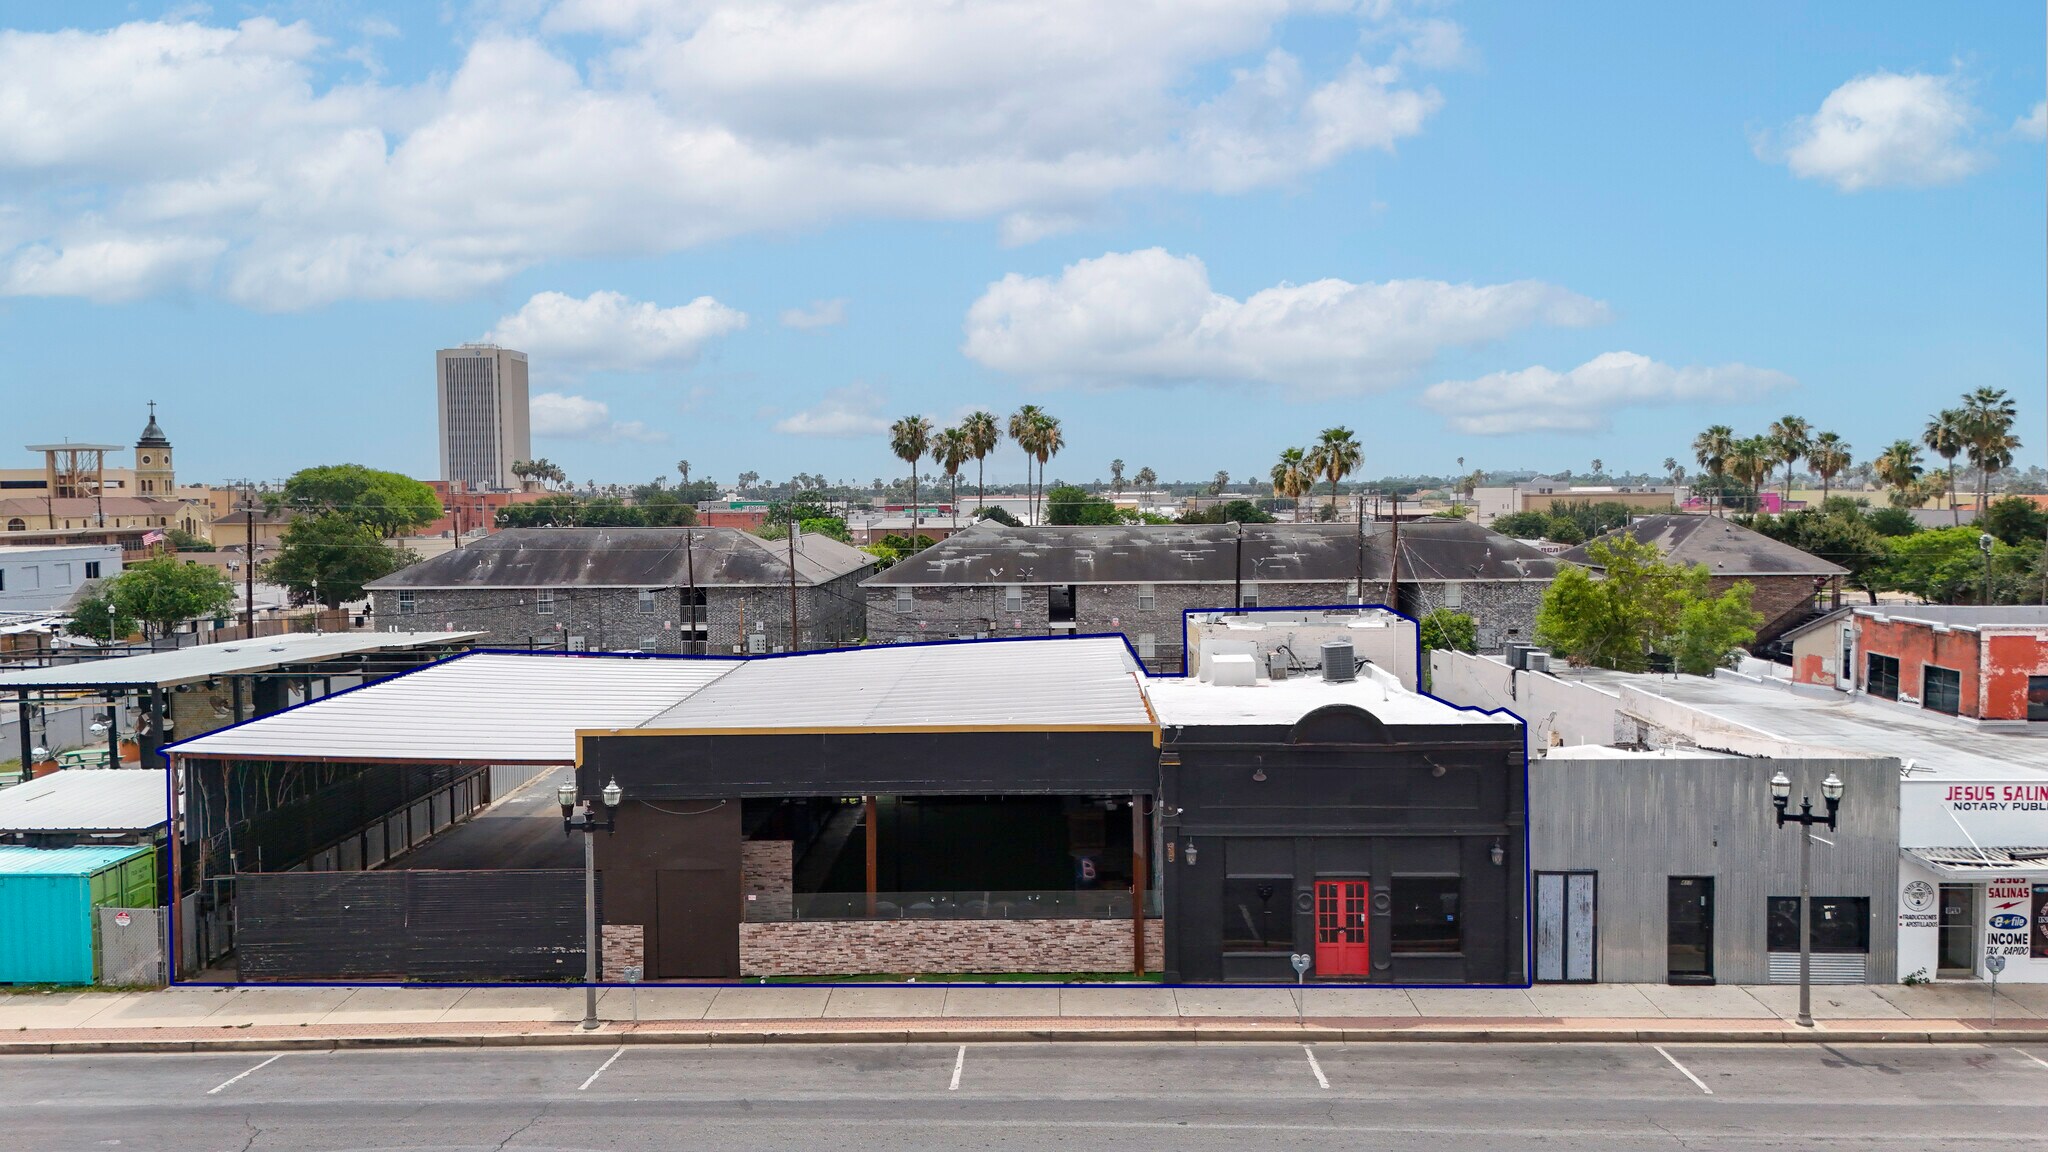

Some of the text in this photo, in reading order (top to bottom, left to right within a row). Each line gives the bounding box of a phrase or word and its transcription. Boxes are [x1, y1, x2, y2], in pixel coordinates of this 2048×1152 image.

[1945, 786, 1995, 801] JESUS
[1953, 802, 2008, 811] NOTARY
[1988, 887, 2030, 898] SALINAS
[1987, 933, 2028, 945] INCOME
[1986, 946, 2029, 956] TAX RAPIDO
